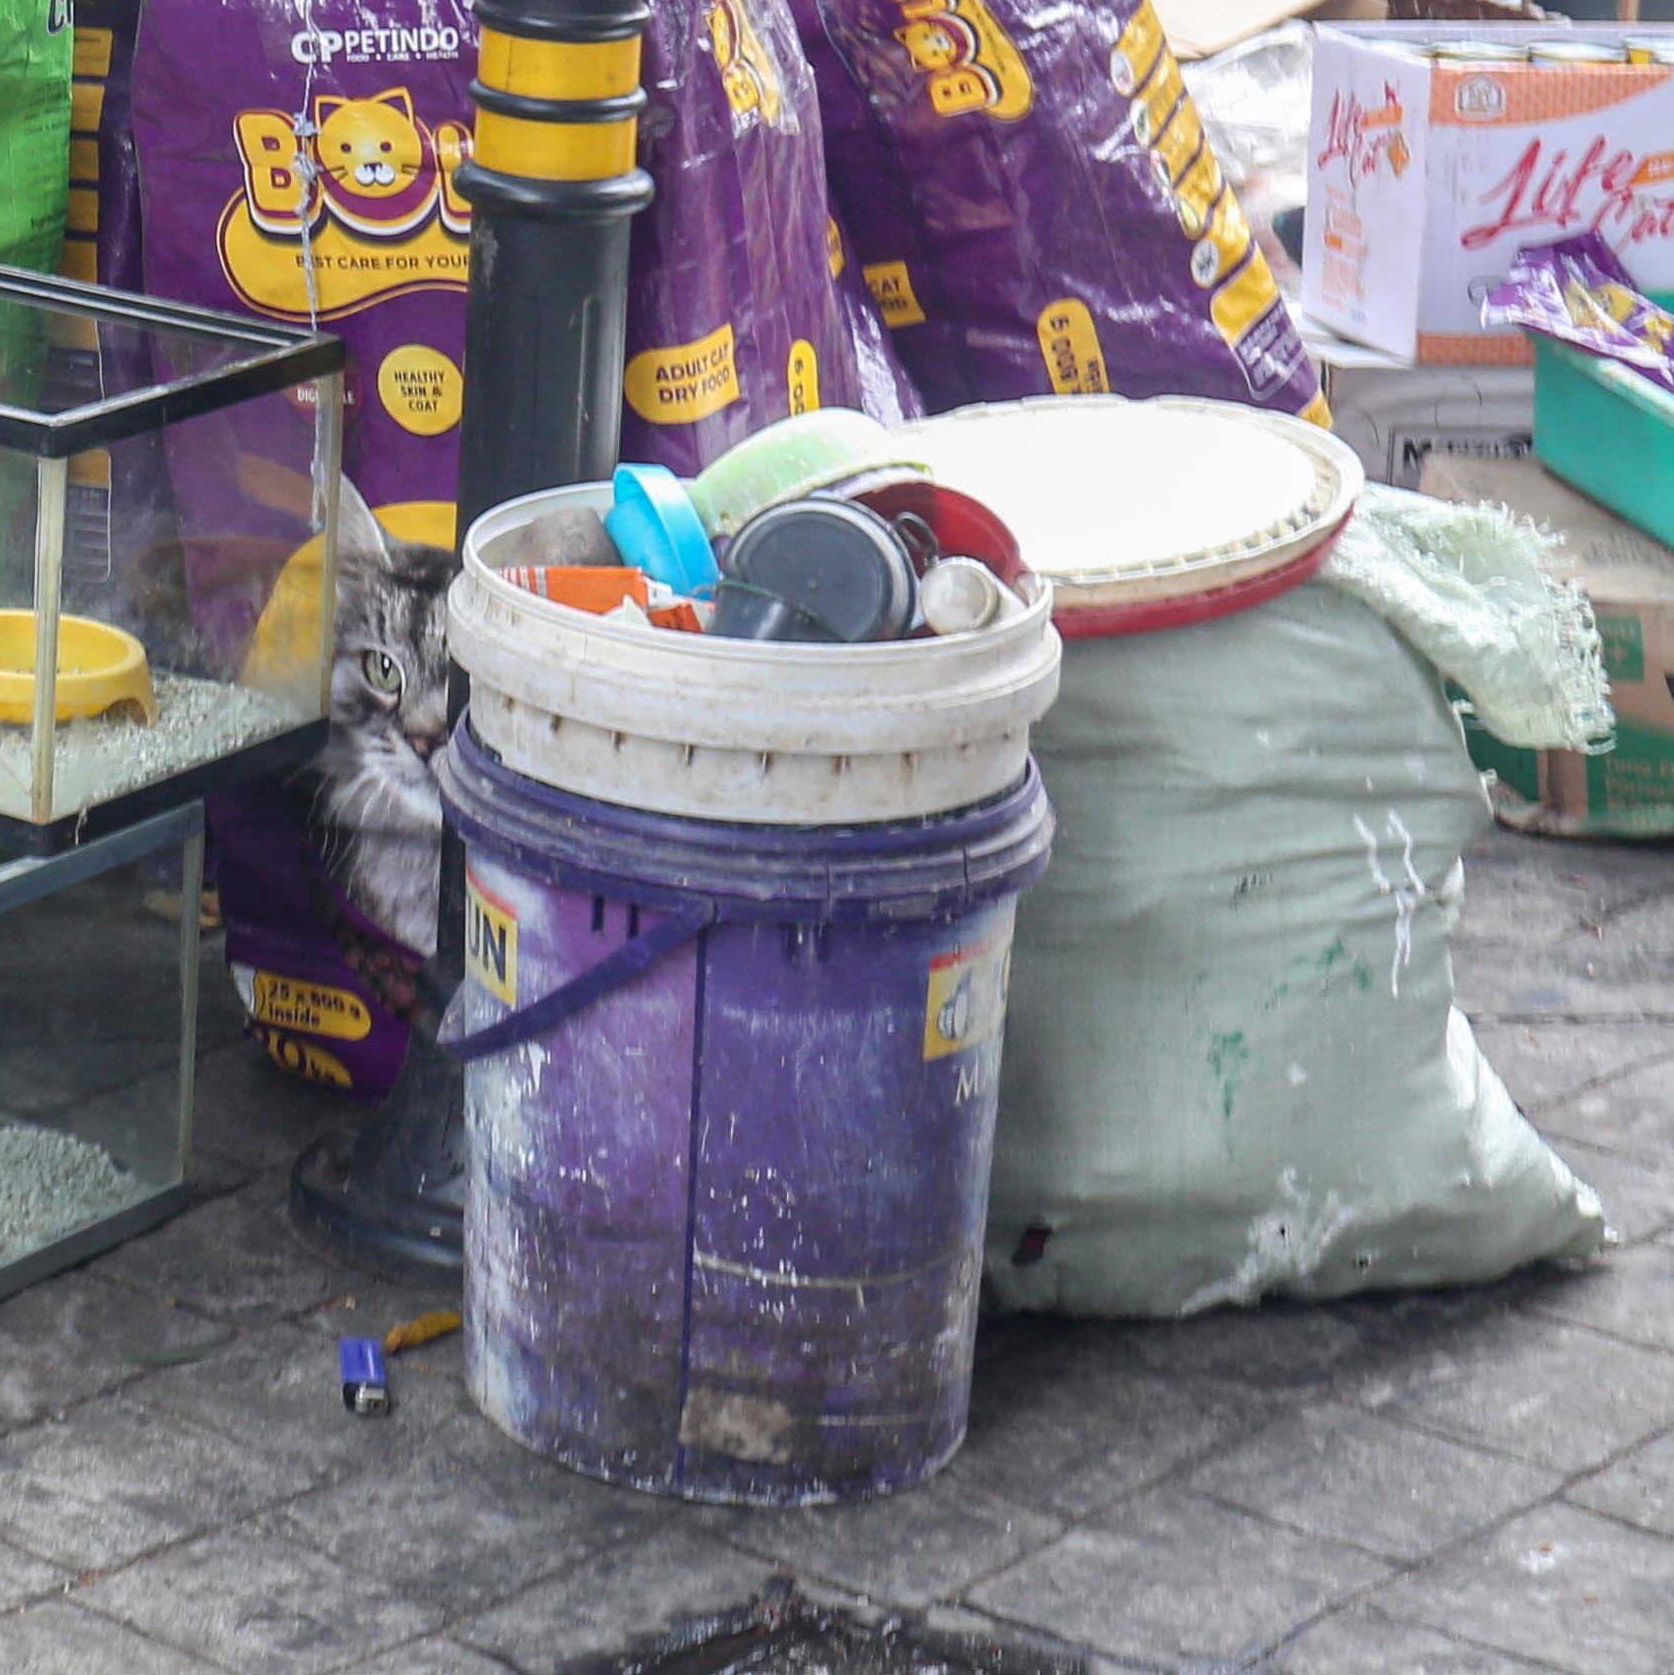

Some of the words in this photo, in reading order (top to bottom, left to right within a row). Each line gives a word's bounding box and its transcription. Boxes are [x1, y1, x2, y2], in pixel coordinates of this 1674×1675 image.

[1460, 134, 1635, 250] Life
[337, 253, 381, 270] CARE
[386, 252, 420, 269] FOR
[655, 355, 709, 383] ADULT
[709, 342, 730, 369] CAT
[394, 370, 445, 383] HEALTHY
[659, 383, 702, 404] DRY
[701, 365, 730, 397] FOOD
[401, 387, 427, 398] SKIN
[408, 400, 438, 413] COAT
[268, 1001, 321, 1028] inside
